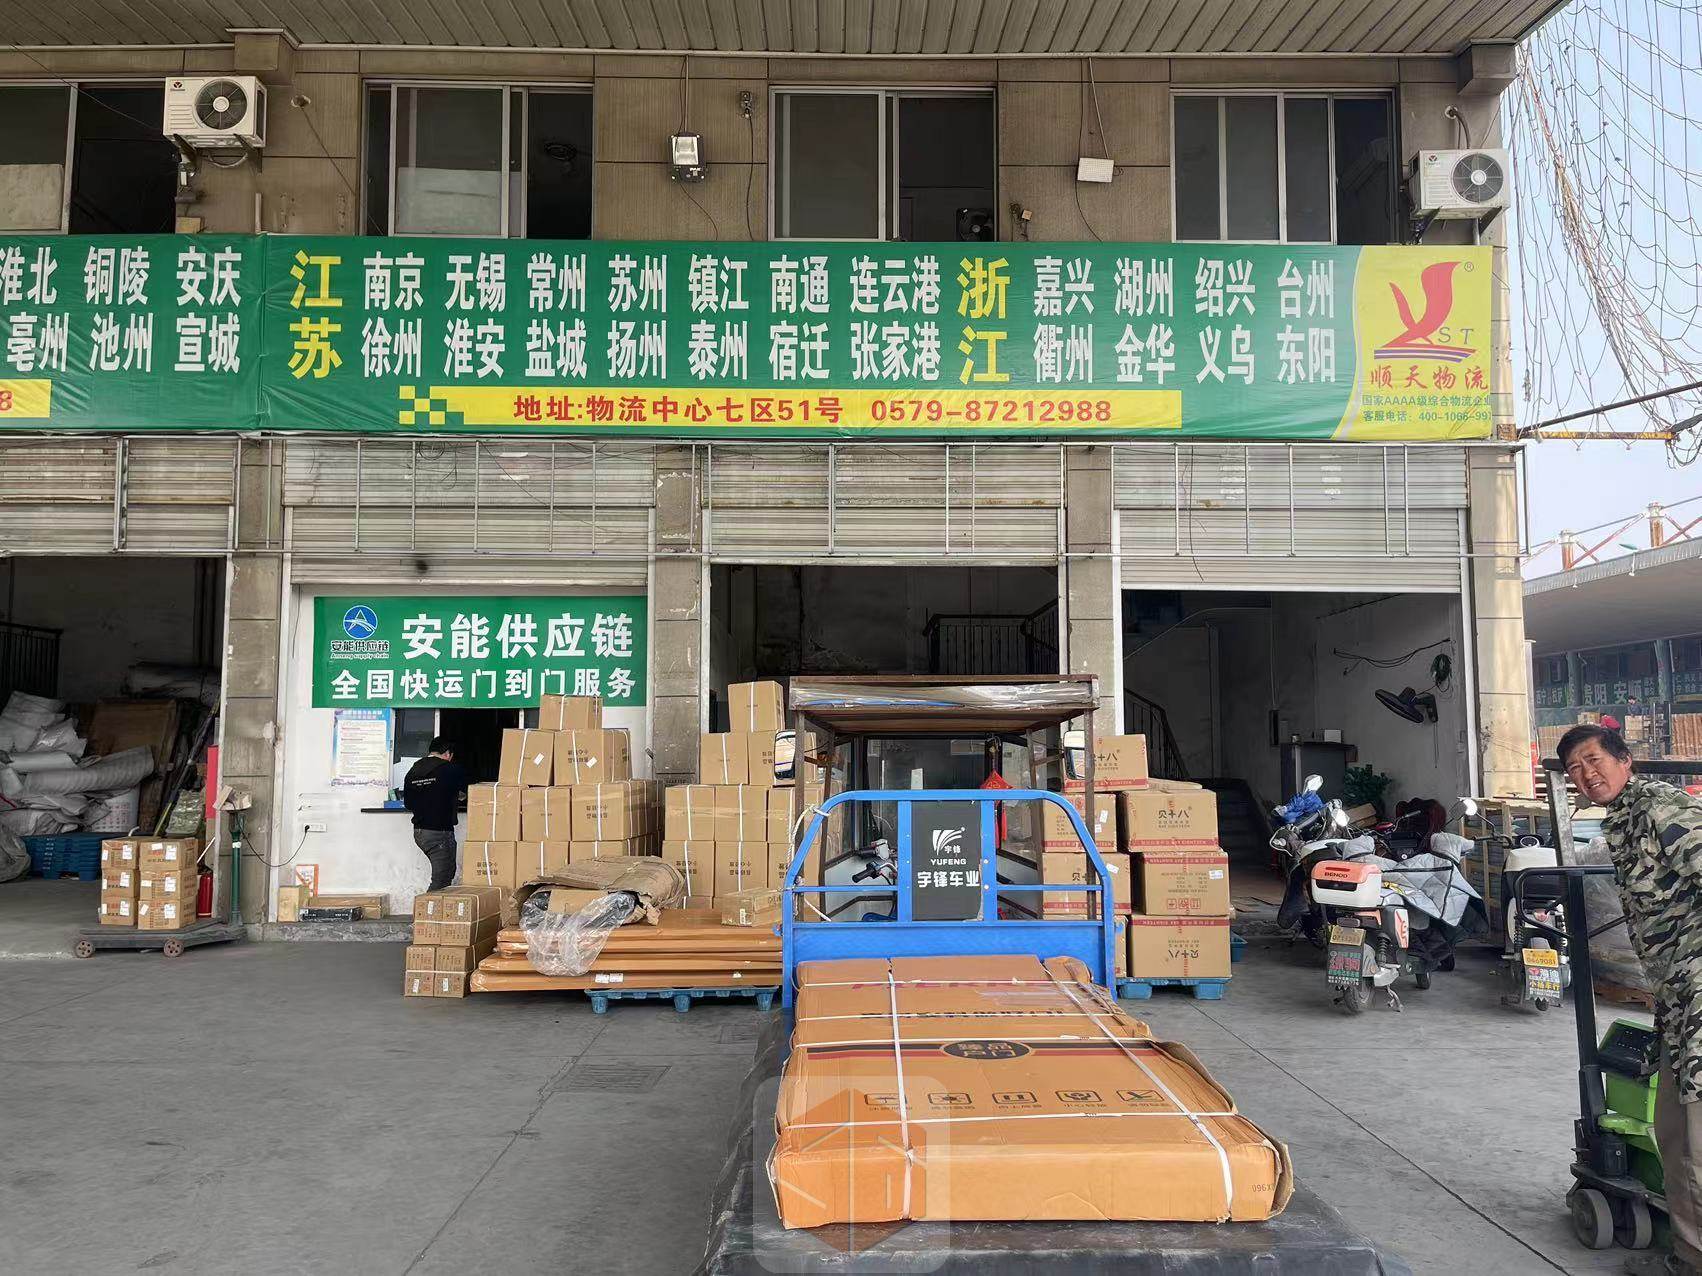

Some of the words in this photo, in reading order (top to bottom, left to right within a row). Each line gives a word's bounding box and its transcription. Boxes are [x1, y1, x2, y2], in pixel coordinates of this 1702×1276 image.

[0, 247, 57, 305] 淮北
[84, 246, 151, 305] 铜陵
[177, 246, 241, 306] 安庆
[364, 252, 424, 310] 南京
[446, 253, 505, 311] 无锡
[528, 253, 585, 312] 常州
[609, 255, 666, 312] 苏州
[689, 255, 748, 313] 镇江
[770, 255, 829, 313] 南通
[850, 256, 940, 313] 连云港
[1034, 256, 1094, 316] 嘉兴
[1114, 258, 1173, 316] 湖州
[1196, 258, 1255, 317] 绍兴
[1277, 258, 1335, 317] 台州
[7, 312, 69, 372] 亳州
[90, 313, 153, 372] 池州
[175, 313, 240, 373] 宣城
[290, 252, 341, 378] 江苏
[959, 258, 1010, 382] 浙江
[361, 317, 421, 377] 徐州
[444, 318, 505, 378] 淮安
[526, 319, 587, 378] 盐城
[608, 320, 666, 379] 扬州
[689, 320, 747, 380] 泰州
[769, 321, 829, 380] 宿迁
[851, 321, 940, 380] 张家港
[1033, 323, 1095, 383] 衢州
[1115, 324, 1175, 384] 金华
[1196, 324, 1256, 384] 义乌
[1277, 327, 1336, 384] 东阳
[1370, 365, 1489, 390] 顺天物流
[515, 396, 842, 423] 地址:物流中心七区51号
[872, 400, 1110, 421] 0579-87212988
[402, 613, 632, 659] 安能供应链
[331, 668, 636, 700] 全国快运门到门服务
[917, 870, 980, 888] 宇锋车业
[930, 858, 967, 866] YUFENG
